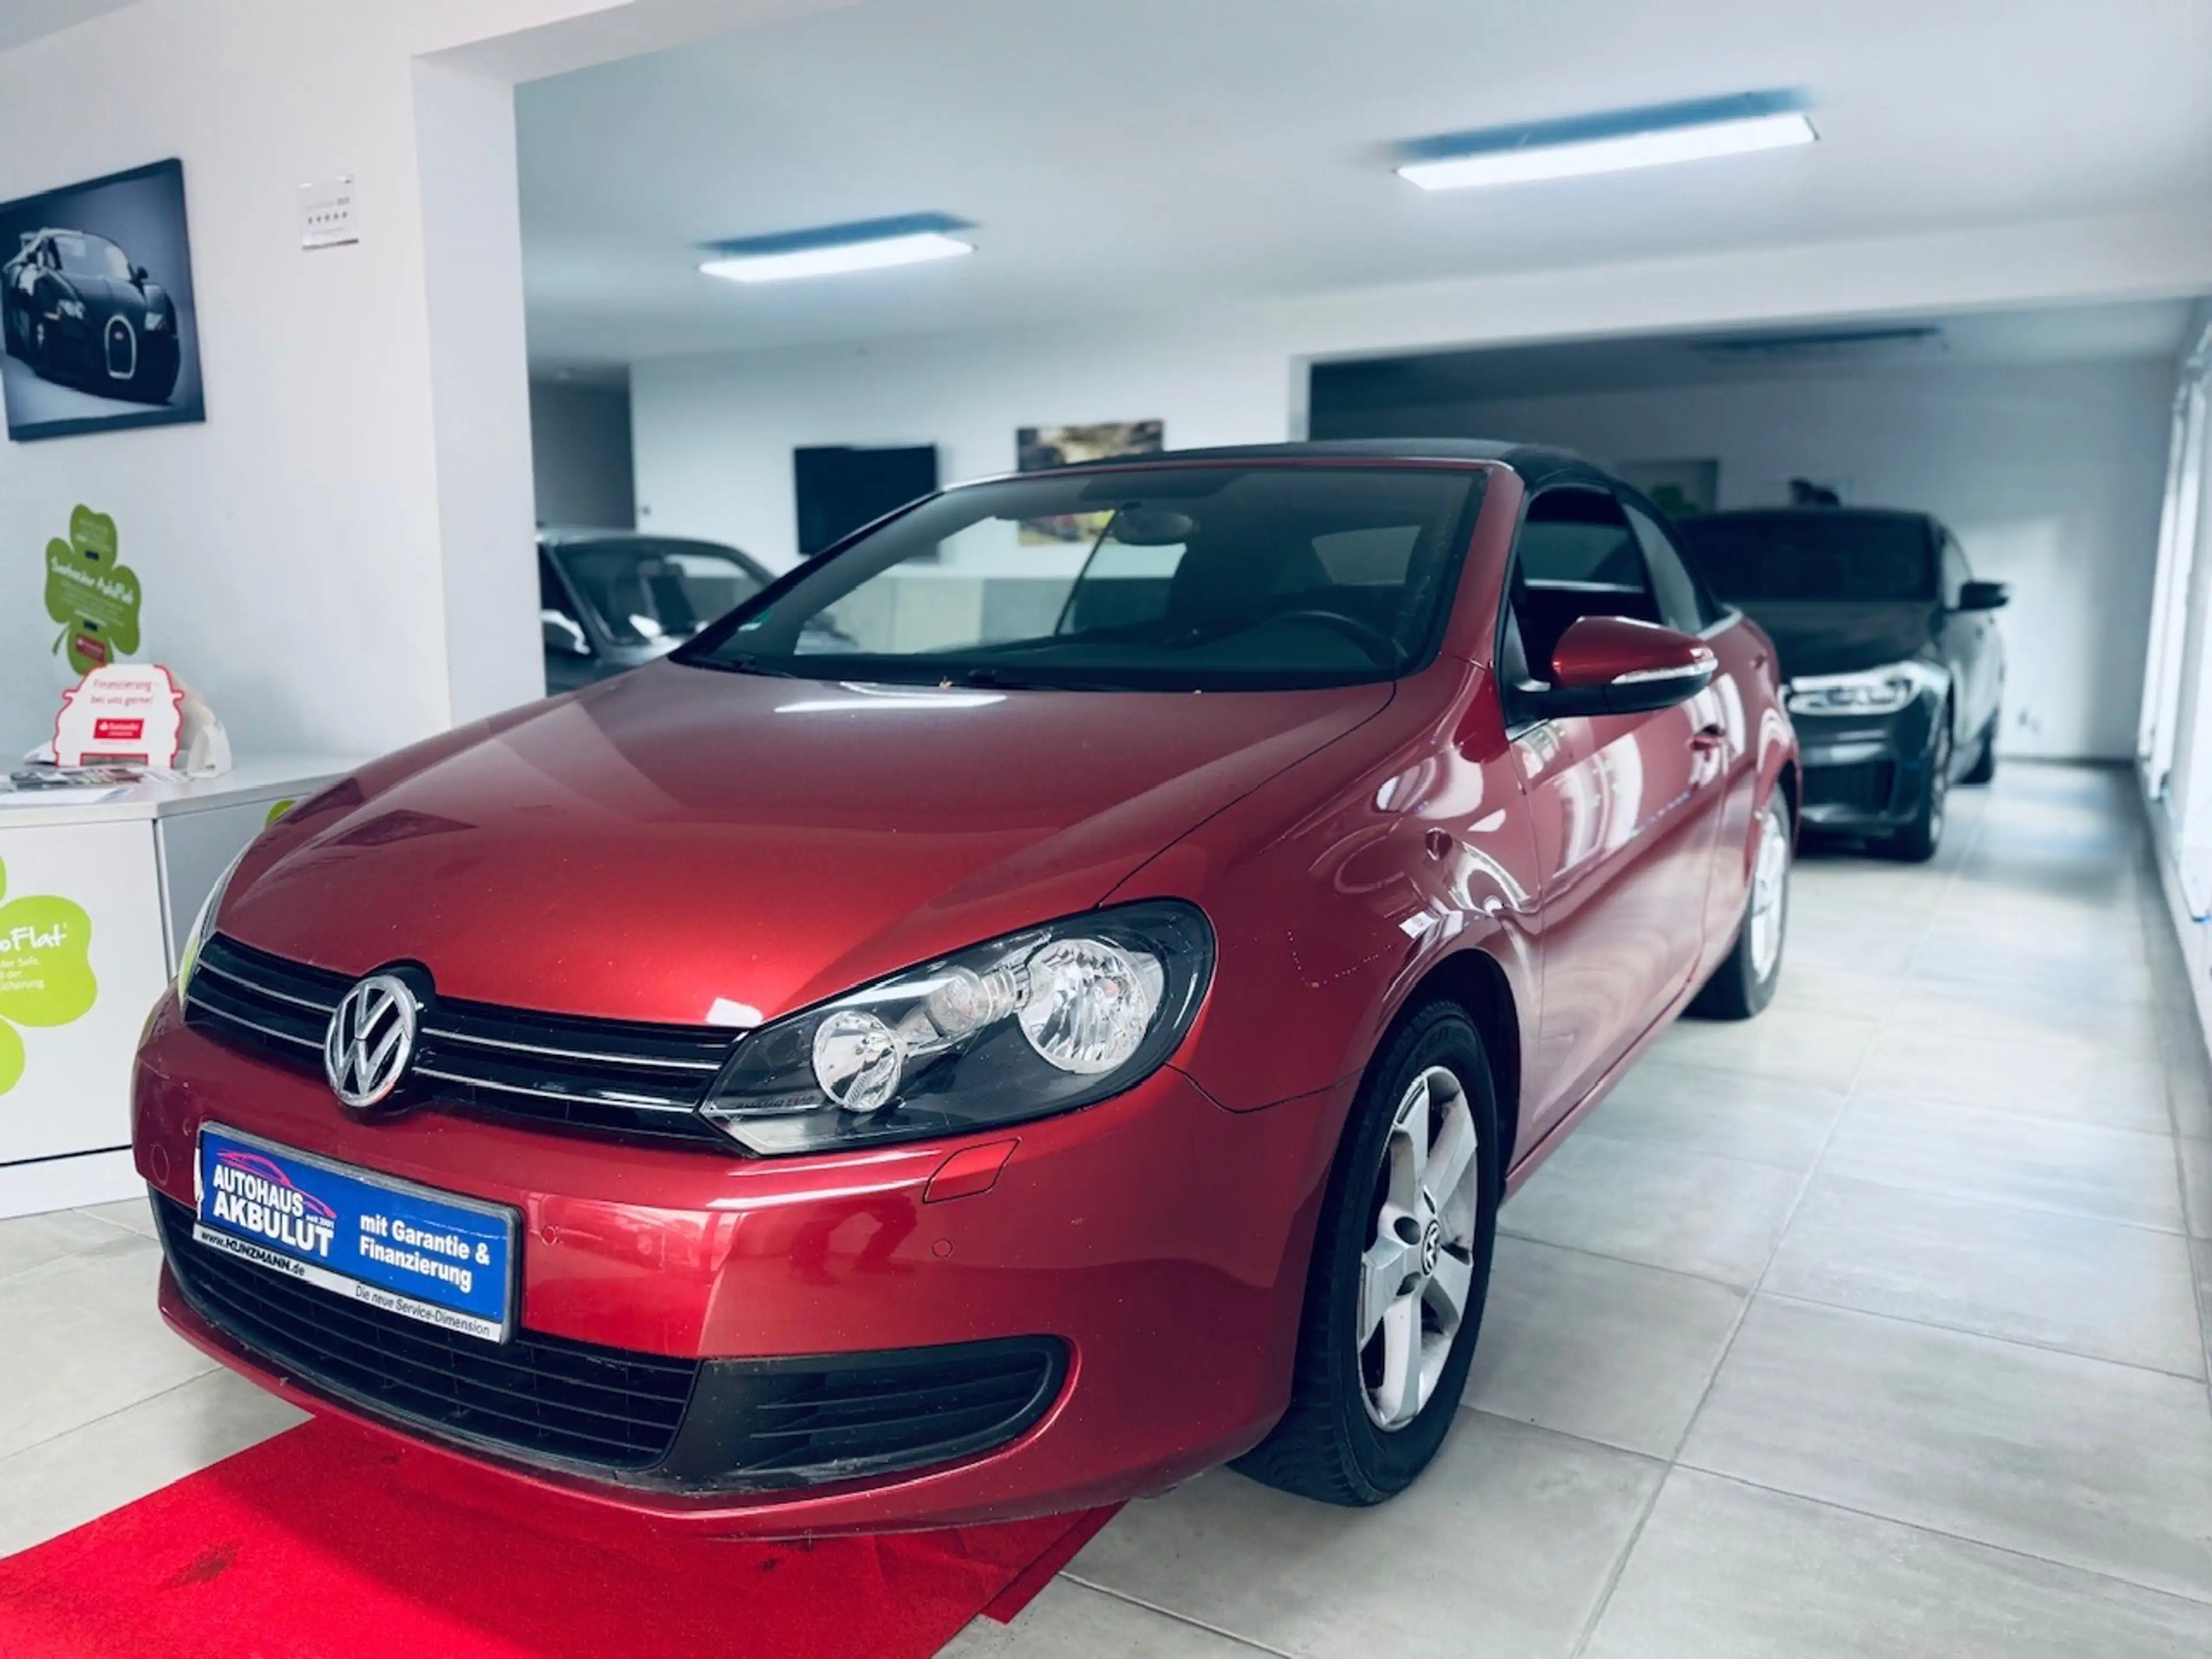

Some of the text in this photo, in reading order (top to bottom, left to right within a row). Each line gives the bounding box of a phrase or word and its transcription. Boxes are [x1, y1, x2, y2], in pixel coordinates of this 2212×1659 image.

[213, 1164, 304, 1217] AUTOHAUS
[213, 1190, 335, 1257] AKBULUT
[359, 1214, 490, 1266] mit Garantie &
[359, 1236, 473, 1294] Finanzierung
[355, 1283, 490, 1338] Die neue Service-Dimension
